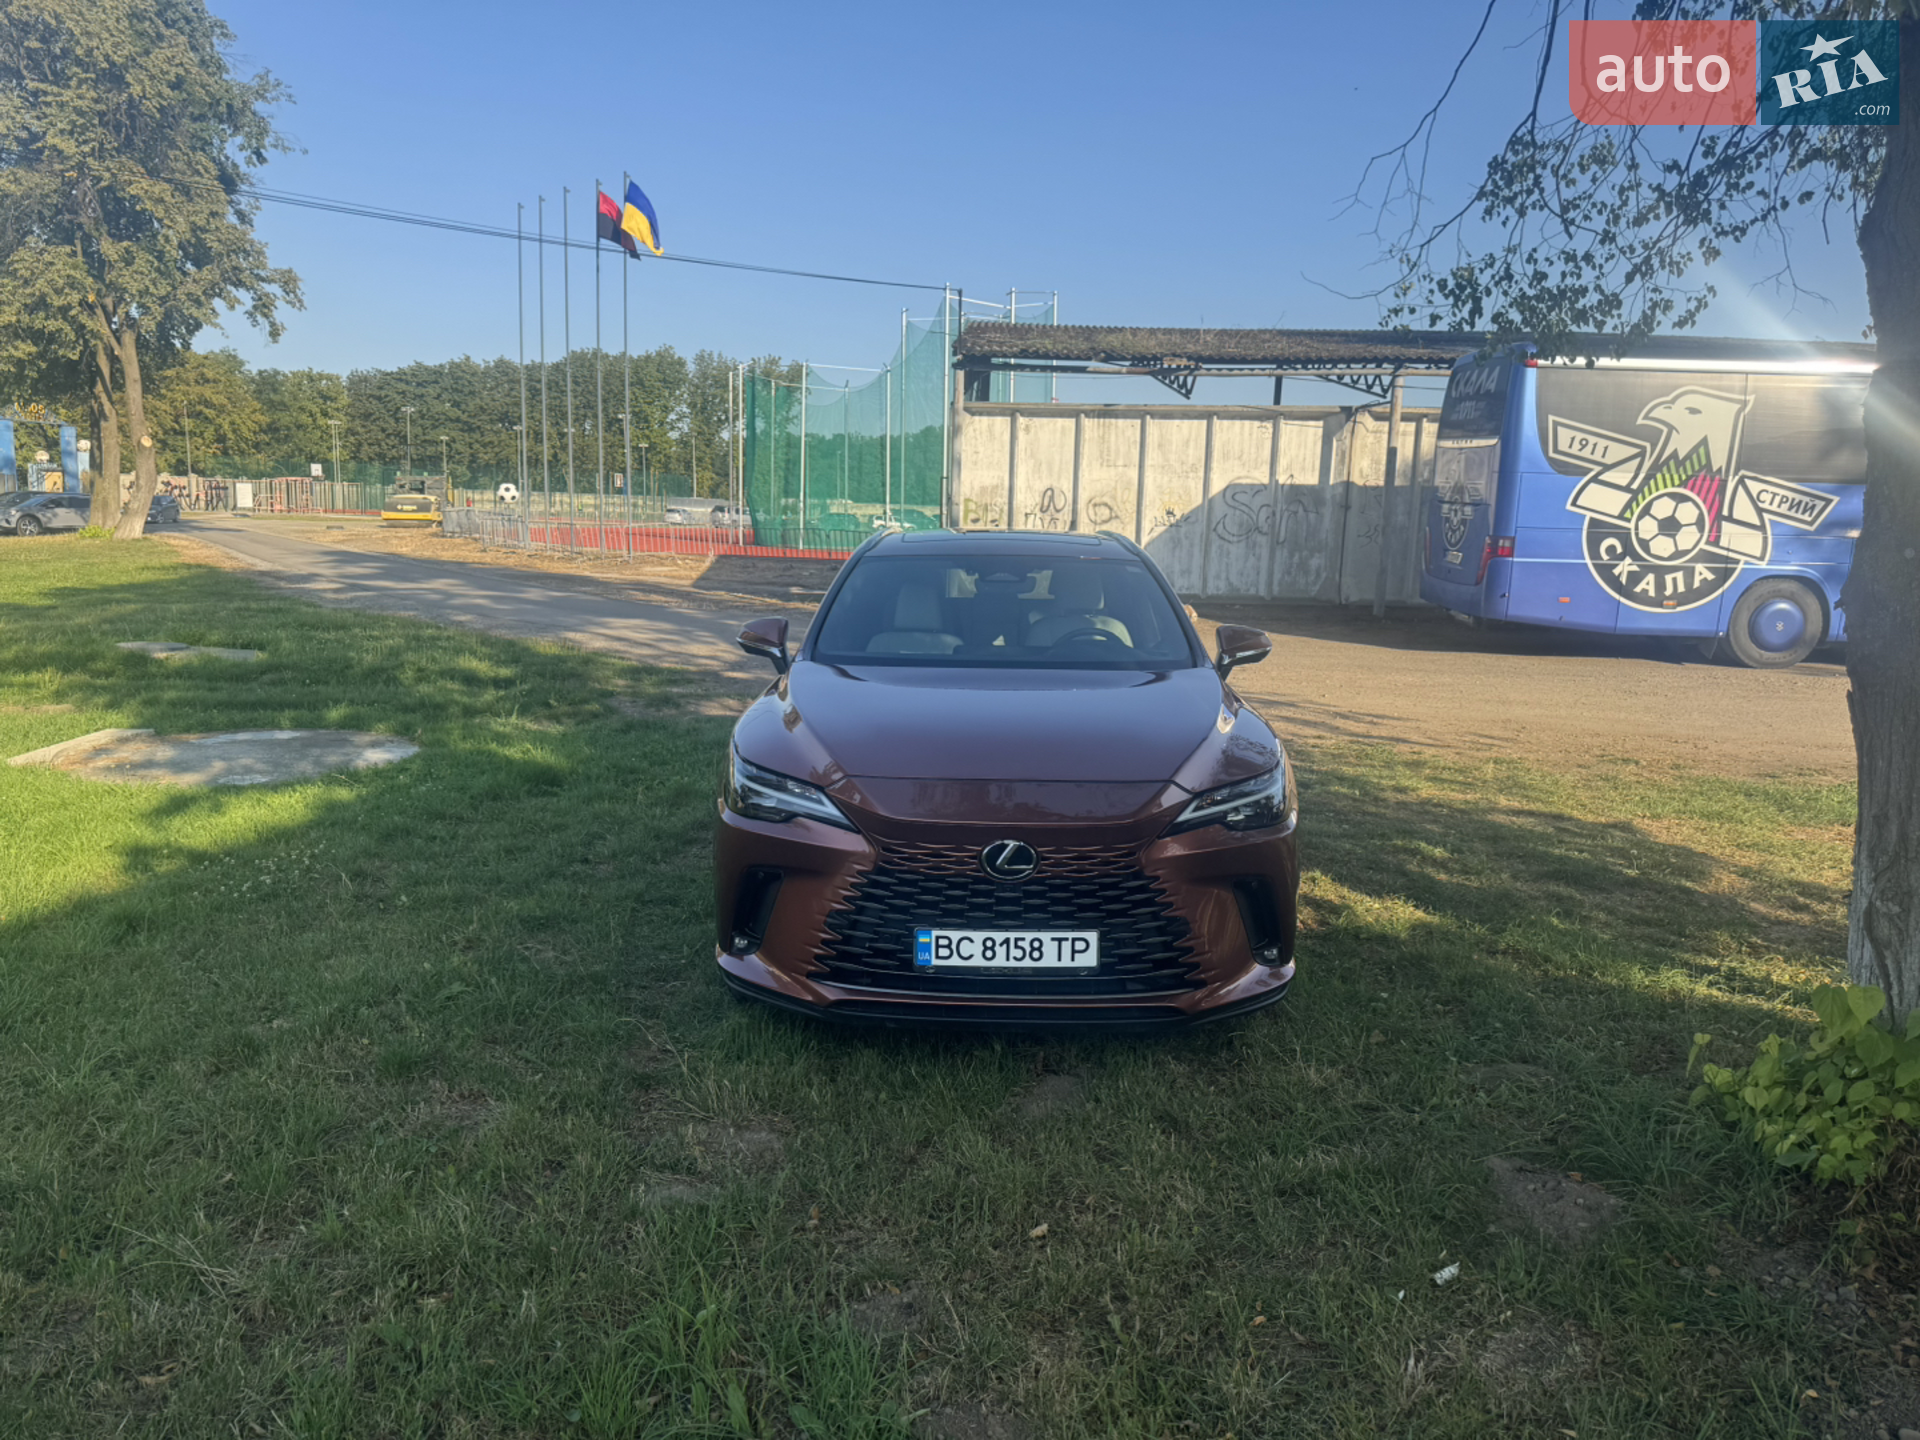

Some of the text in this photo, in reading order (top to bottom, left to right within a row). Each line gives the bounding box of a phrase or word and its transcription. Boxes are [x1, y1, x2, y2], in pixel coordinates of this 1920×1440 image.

[1451, 366, 1500, 398] СКАЛА
[1567, 434, 1610, 459] 1911
[1756, 489, 1818, 519] СТРИЙ
[1599, 536, 1717, 598] СКАЛА
[918, 951, 930, 961] UA
[934, 935, 1091, 962] BC 8158 TP
